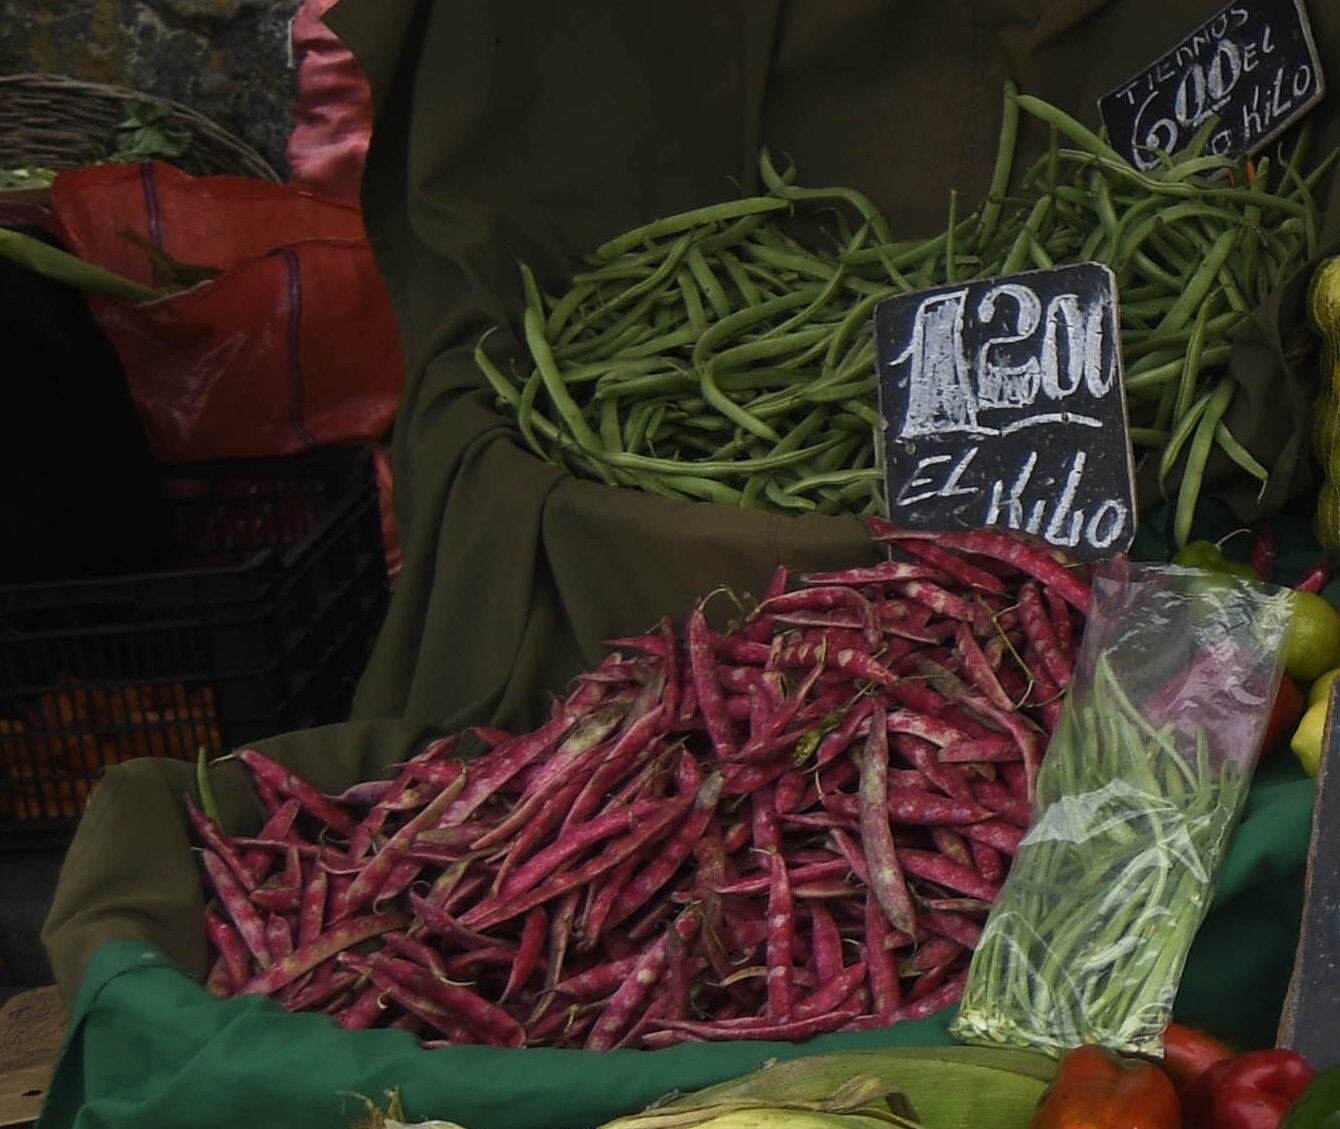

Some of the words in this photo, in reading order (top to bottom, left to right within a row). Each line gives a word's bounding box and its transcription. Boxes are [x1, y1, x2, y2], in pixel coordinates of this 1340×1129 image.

[1116, 8, 1250, 105] TIERNOS
[1132, 38, 1242, 172] 600
[889, 284, 1117, 441] 1200
